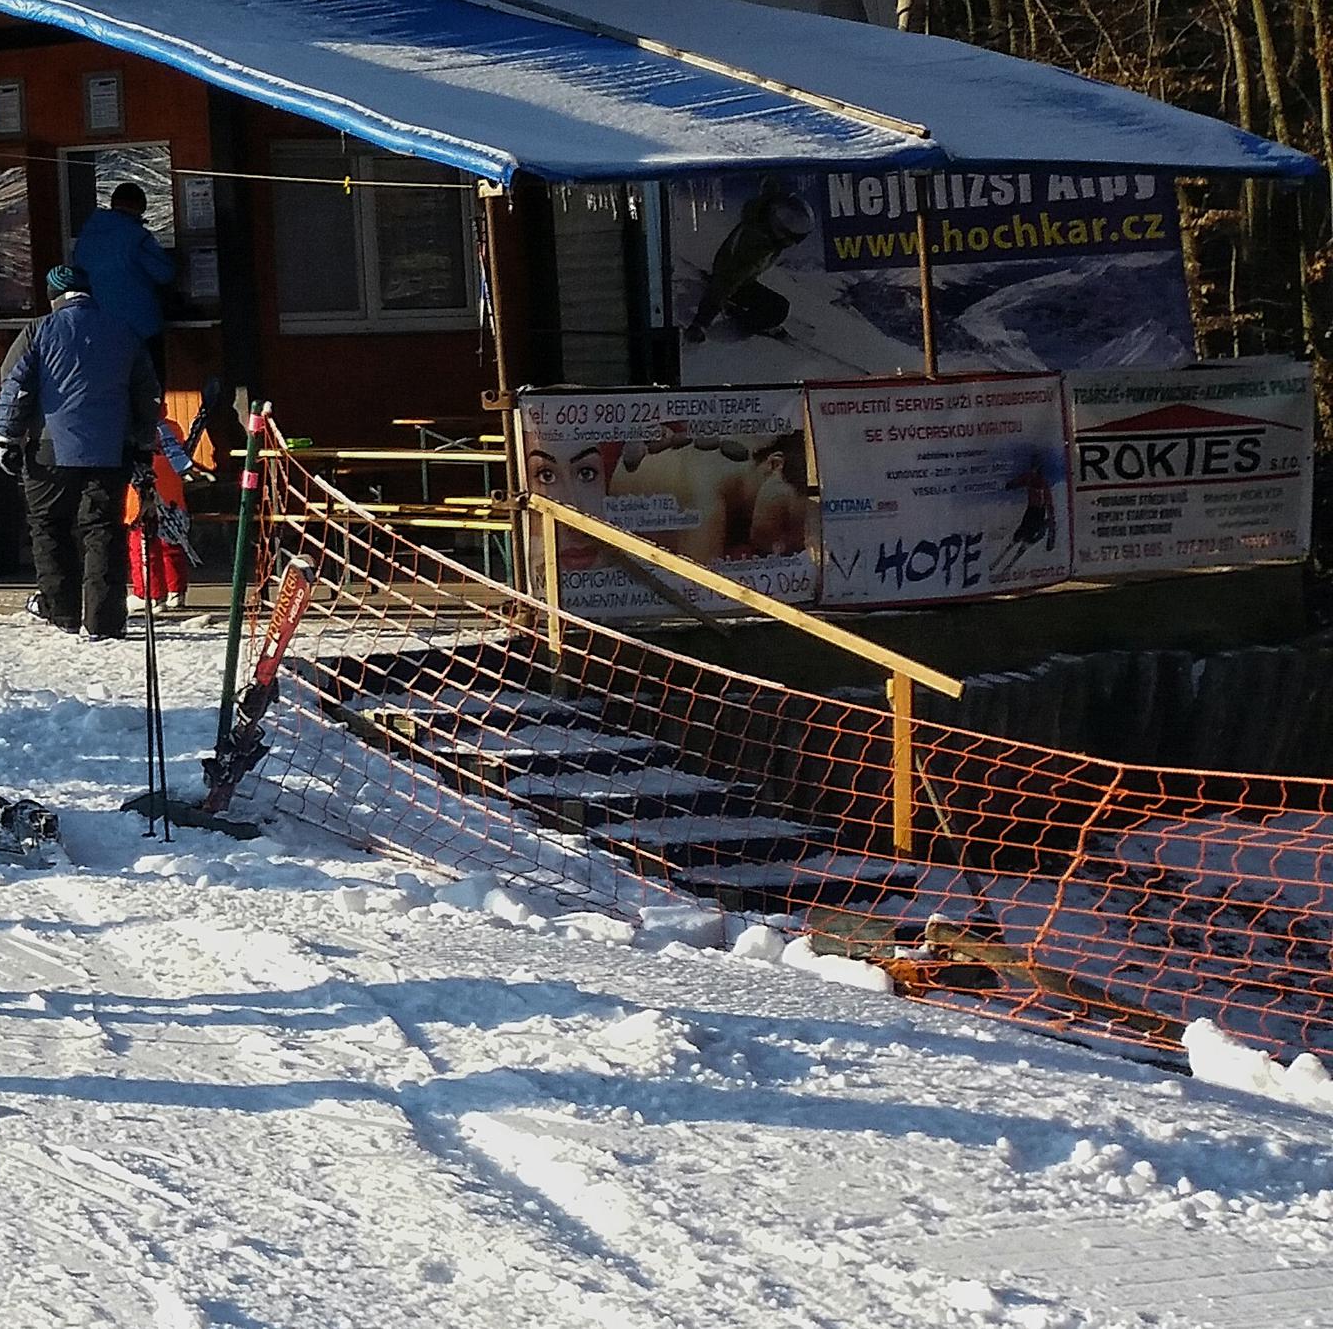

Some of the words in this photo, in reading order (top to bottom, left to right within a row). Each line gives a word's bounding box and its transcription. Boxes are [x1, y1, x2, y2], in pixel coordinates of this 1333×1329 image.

[834, 213, 1165, 260] www.hochkar.cz
[556, 405, 588, 425] 603
[595, 404, 625, 423] 980
[632, 403, 660, 423] 224
[896, 397, 944, 412] SERVIS
[1079, 437, 1261, 481] ROKIES
[875, 532, 984, 590] HOPE
